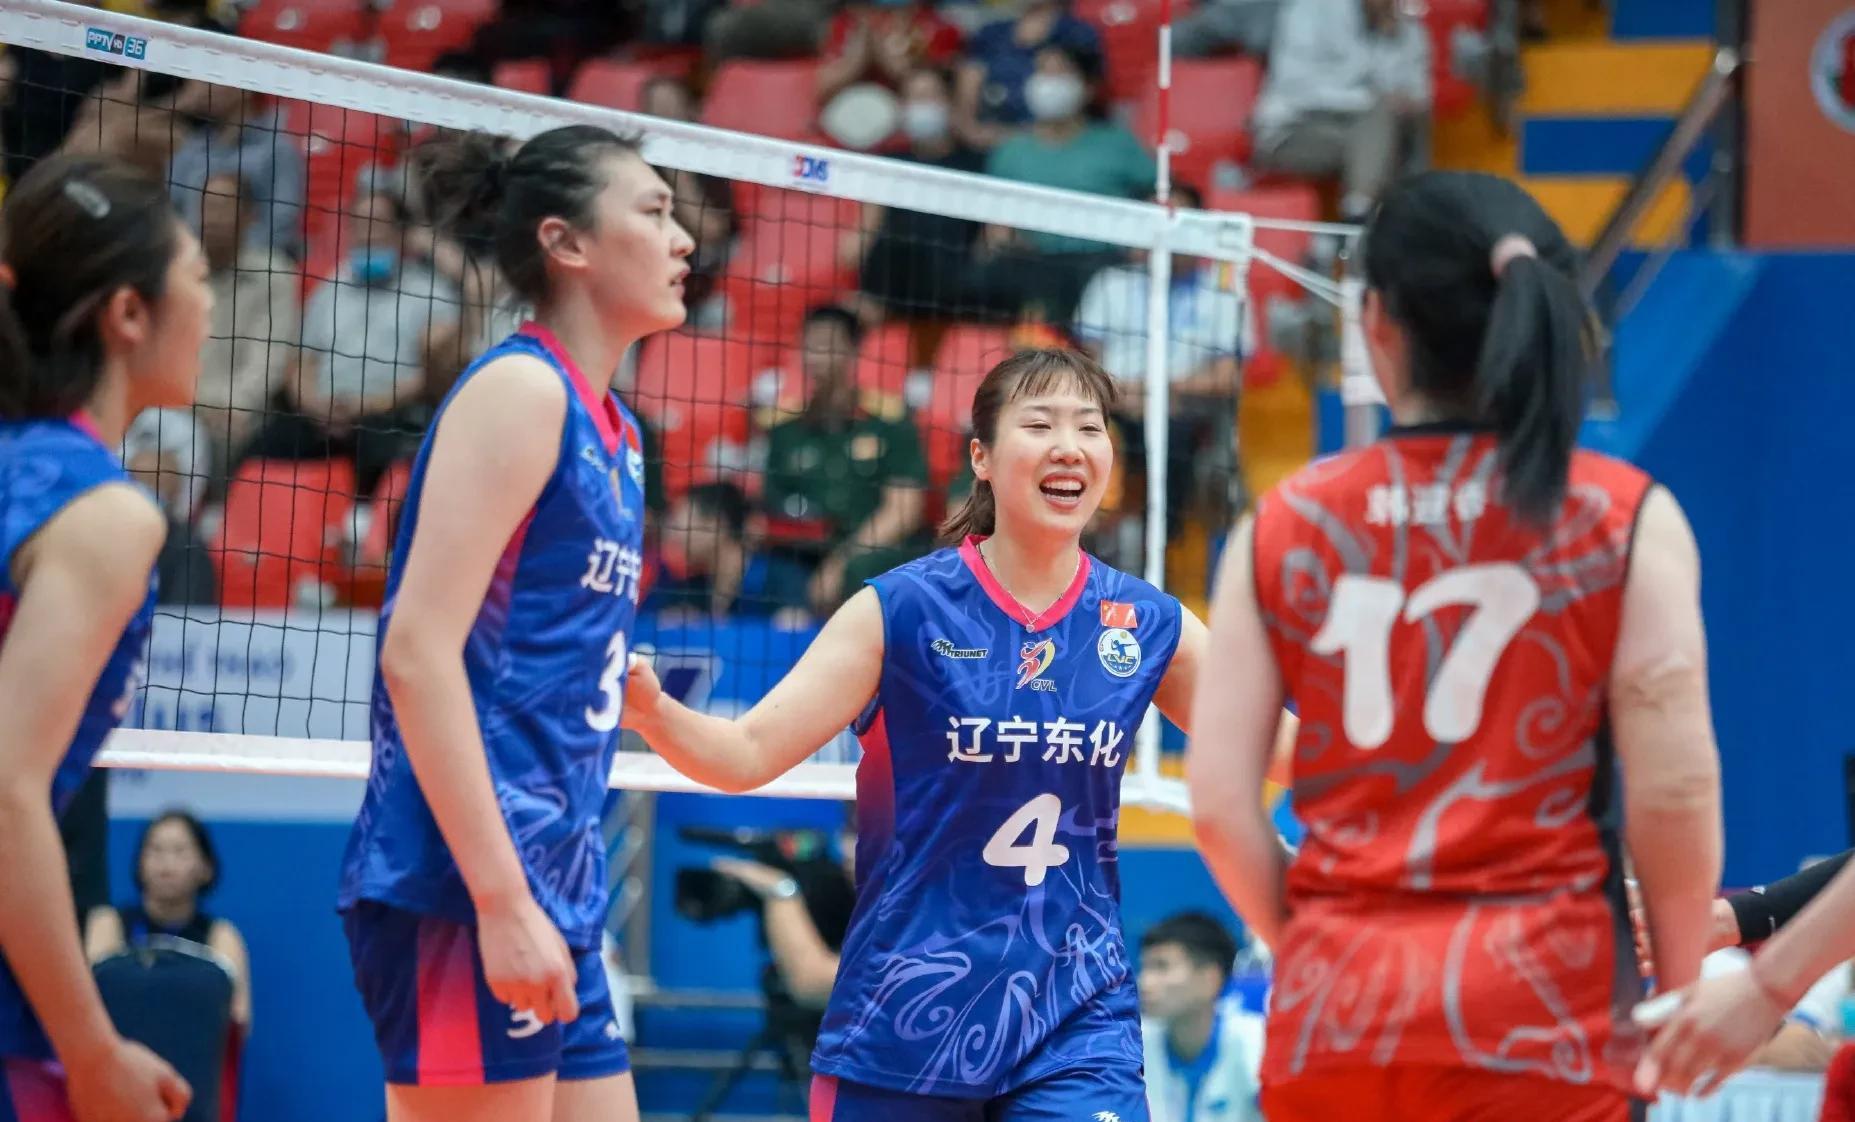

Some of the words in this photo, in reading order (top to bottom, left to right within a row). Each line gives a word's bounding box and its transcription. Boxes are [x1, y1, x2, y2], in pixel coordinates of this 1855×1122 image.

[88, 31, 113, 51] PPTV
[127, 38, 144, 55] 36
[585, 630, 626, 732] 3
[1031, 679, 1057, 692] CVL
[1310, 561, 1541, 750] 17
[946, 715, 1124, 768] 辽宁东化
[982, 793, 1070, 887] 4
